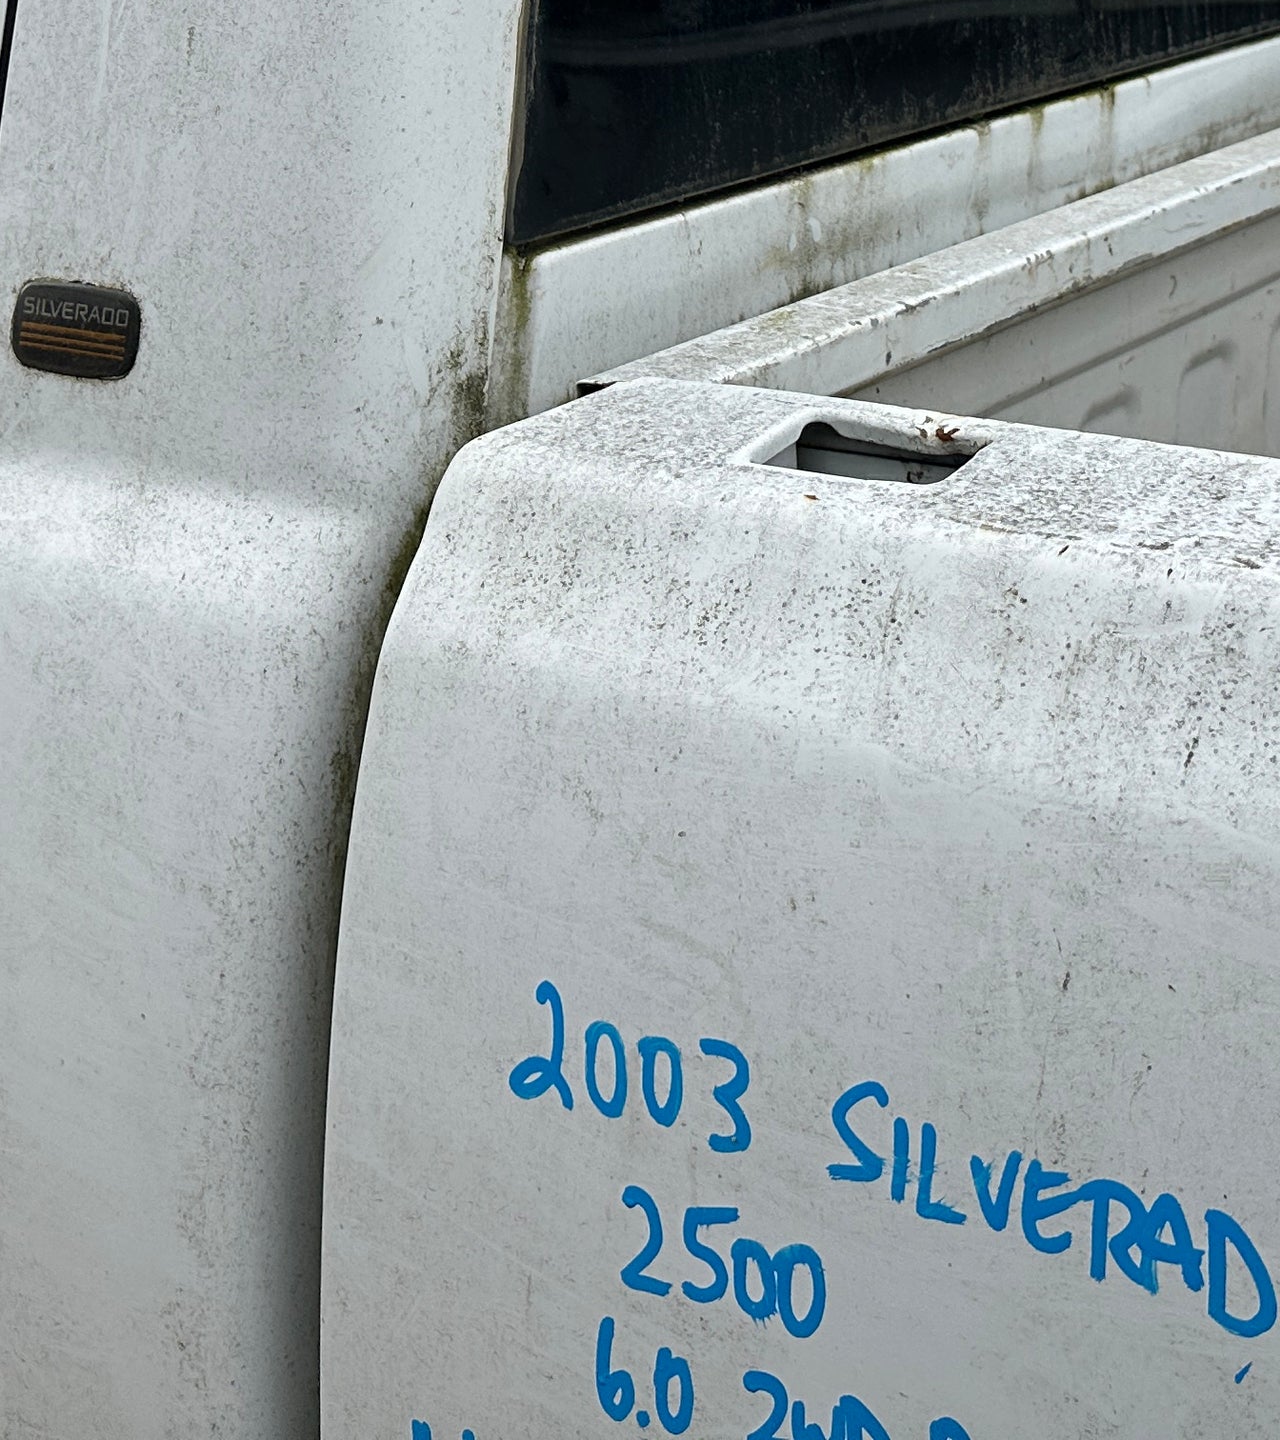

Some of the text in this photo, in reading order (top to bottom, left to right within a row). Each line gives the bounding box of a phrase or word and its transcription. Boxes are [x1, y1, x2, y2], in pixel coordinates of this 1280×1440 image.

[22, 297, 130, 327] SILVERADO
[508, 980, 752, 1154] 2003
[620, 1185, 827, 1339] 2500
[595, 1316, 695, 1436] 6.0
